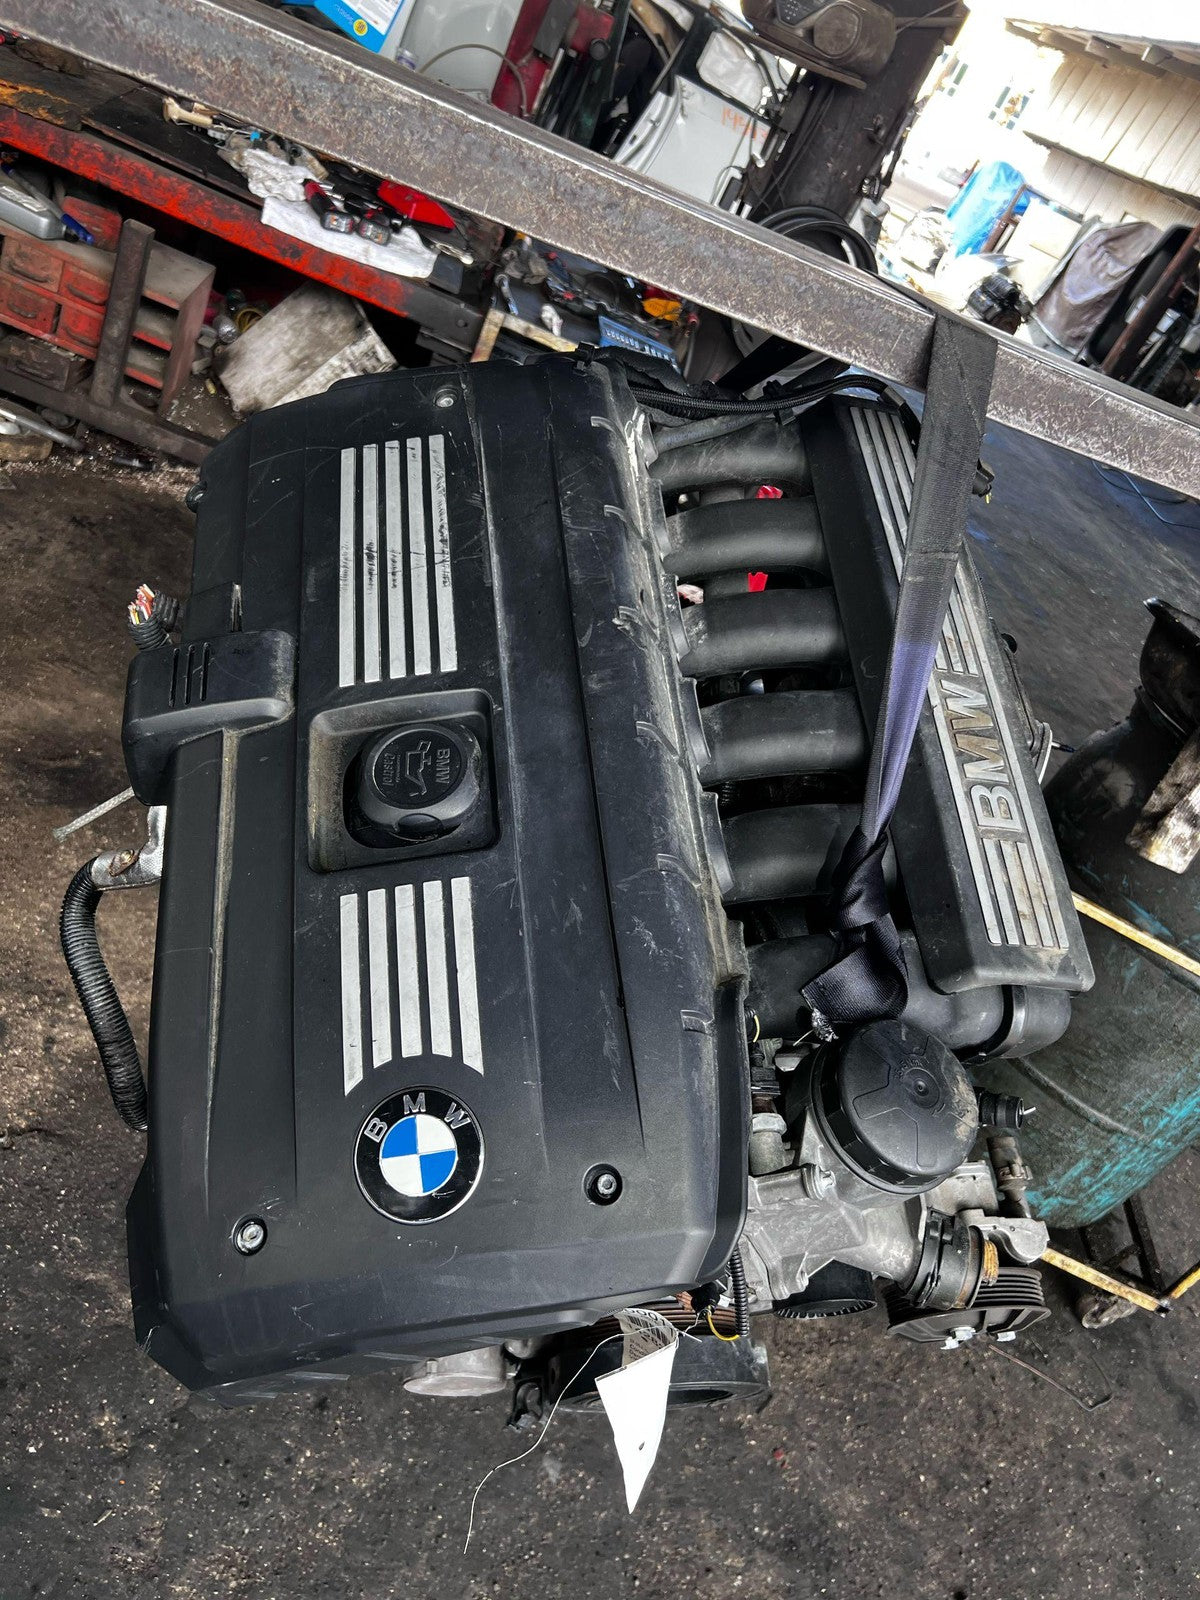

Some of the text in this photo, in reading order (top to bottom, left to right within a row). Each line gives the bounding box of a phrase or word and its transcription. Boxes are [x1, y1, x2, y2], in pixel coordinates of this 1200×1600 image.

[382, 752, 396, 787] Castrol
[435, 747, 451, 784] BMW
[940, 679, 1022, 832] BMW
[364, 1092, 472, 1144] BMW
